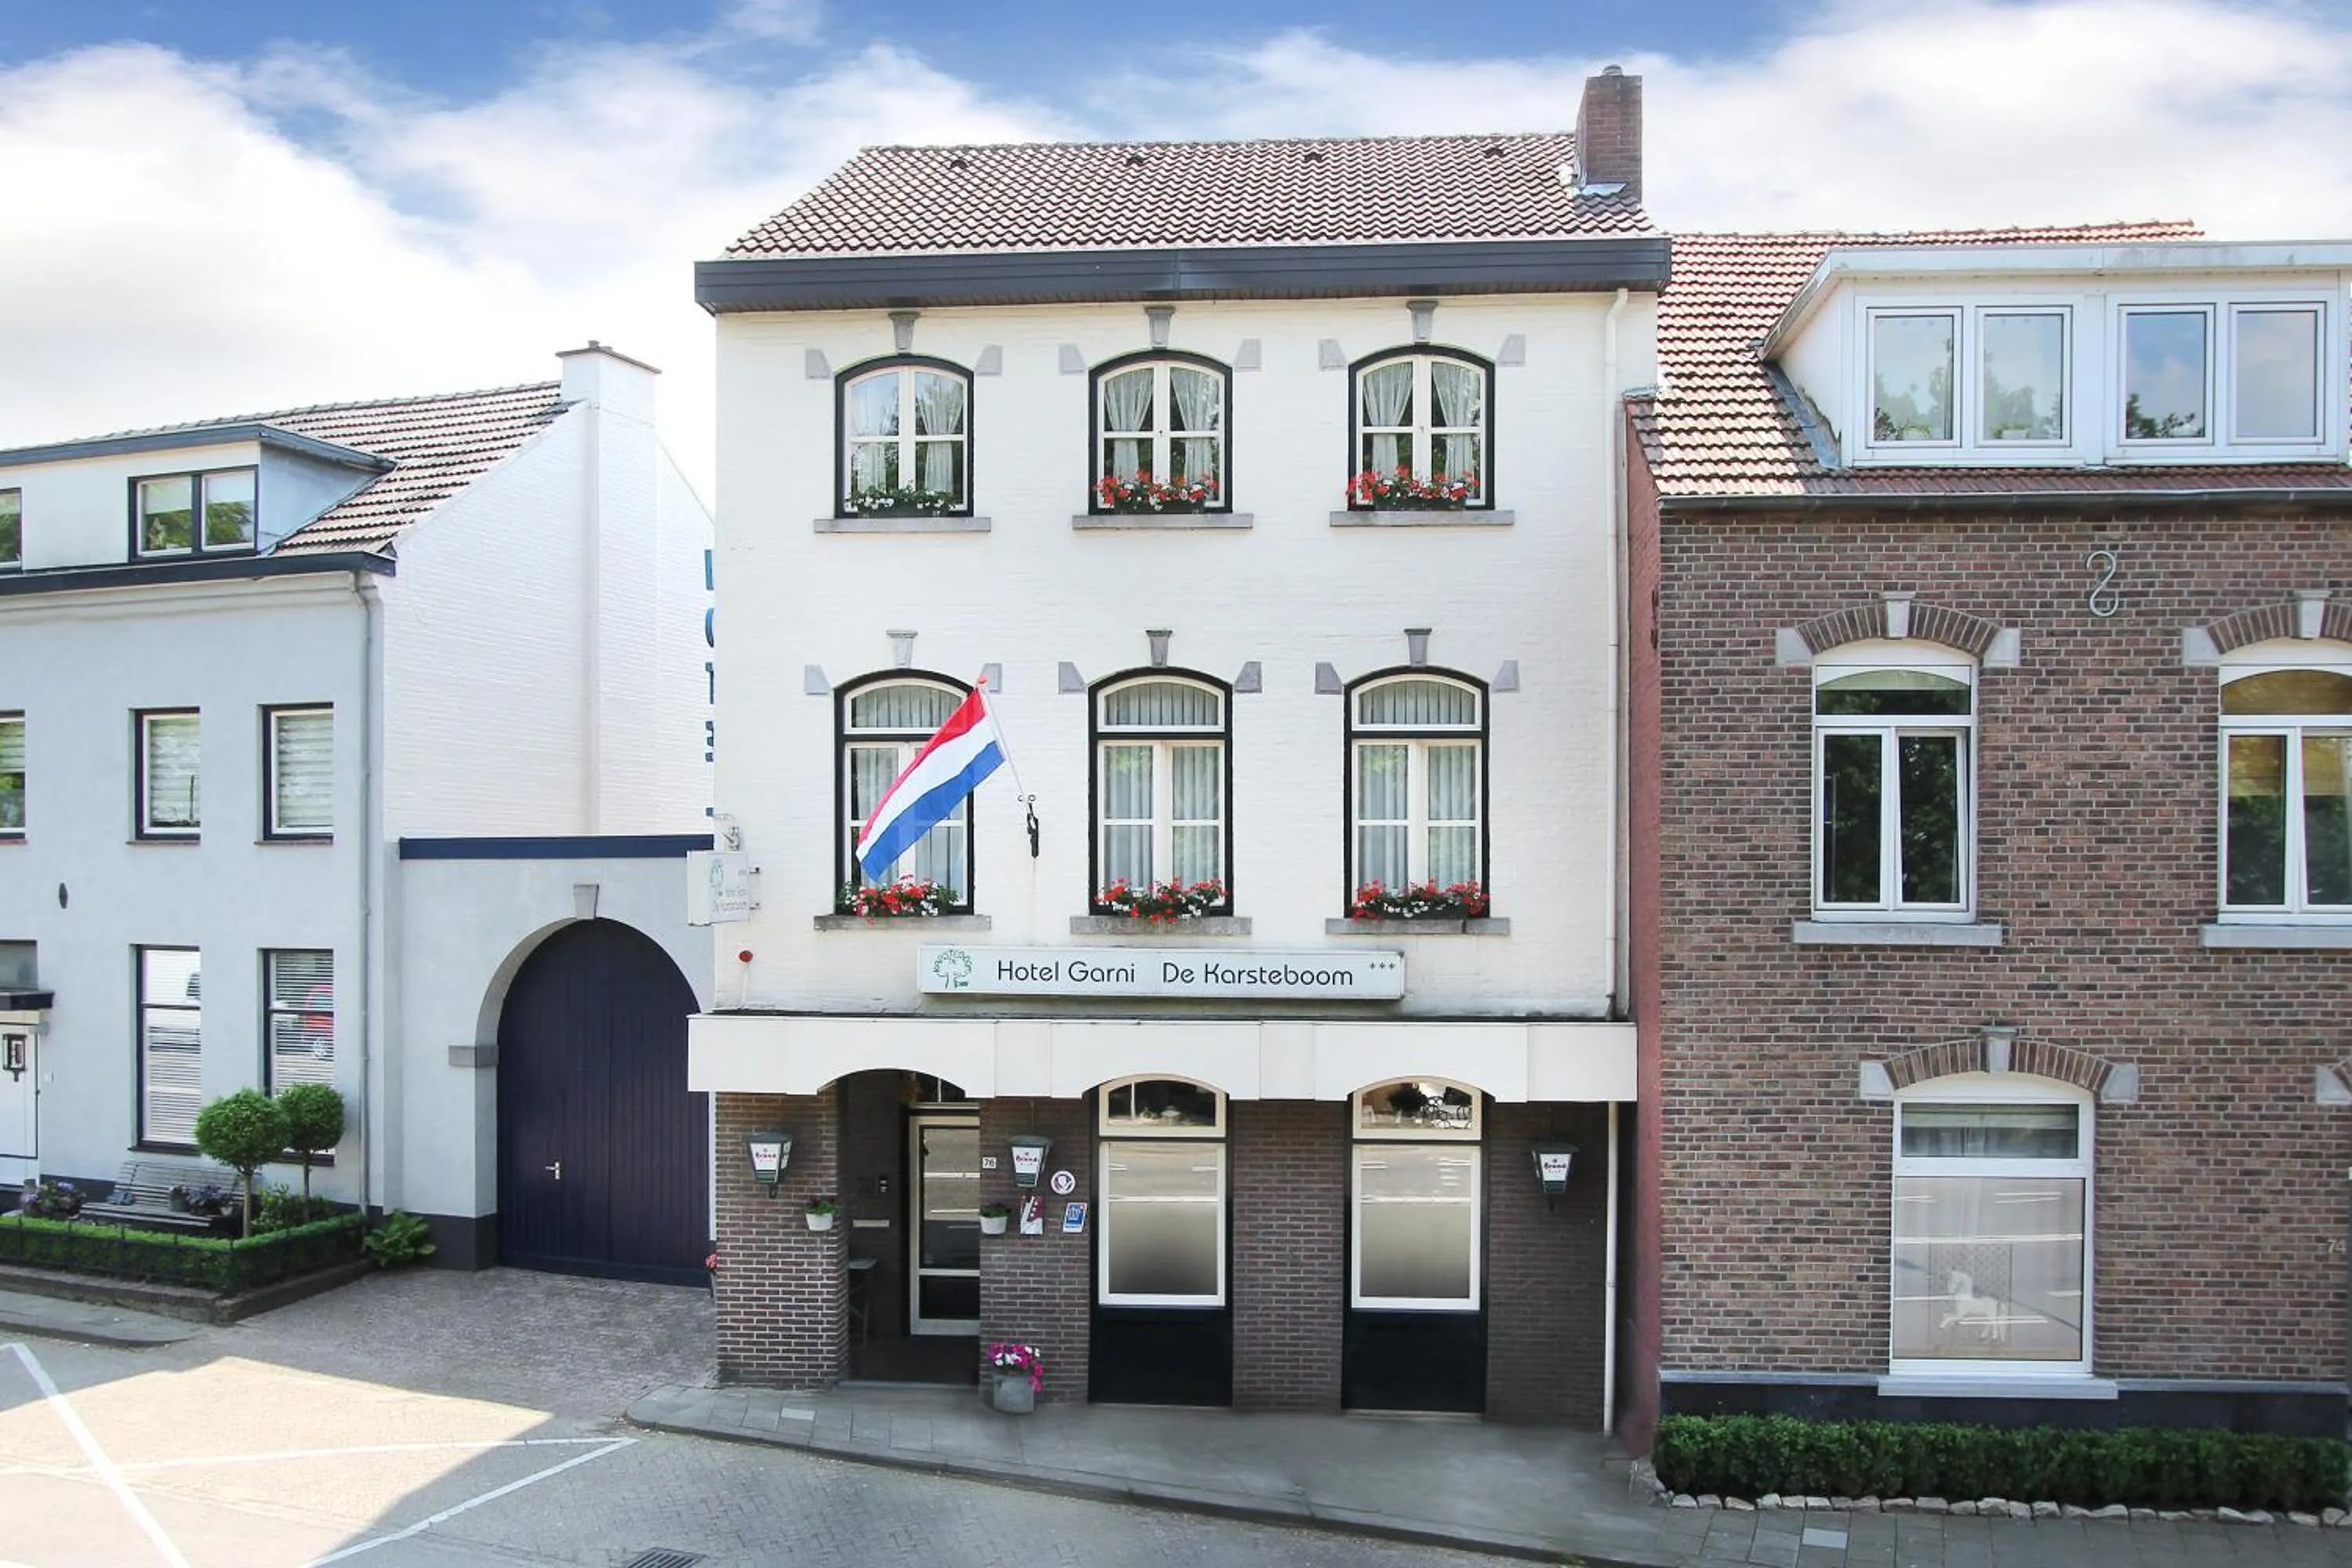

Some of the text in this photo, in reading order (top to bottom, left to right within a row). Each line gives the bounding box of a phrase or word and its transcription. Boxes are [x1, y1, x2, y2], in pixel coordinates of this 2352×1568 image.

[998, 960, 1353, 985] Hotel Garni De Karsteboom
